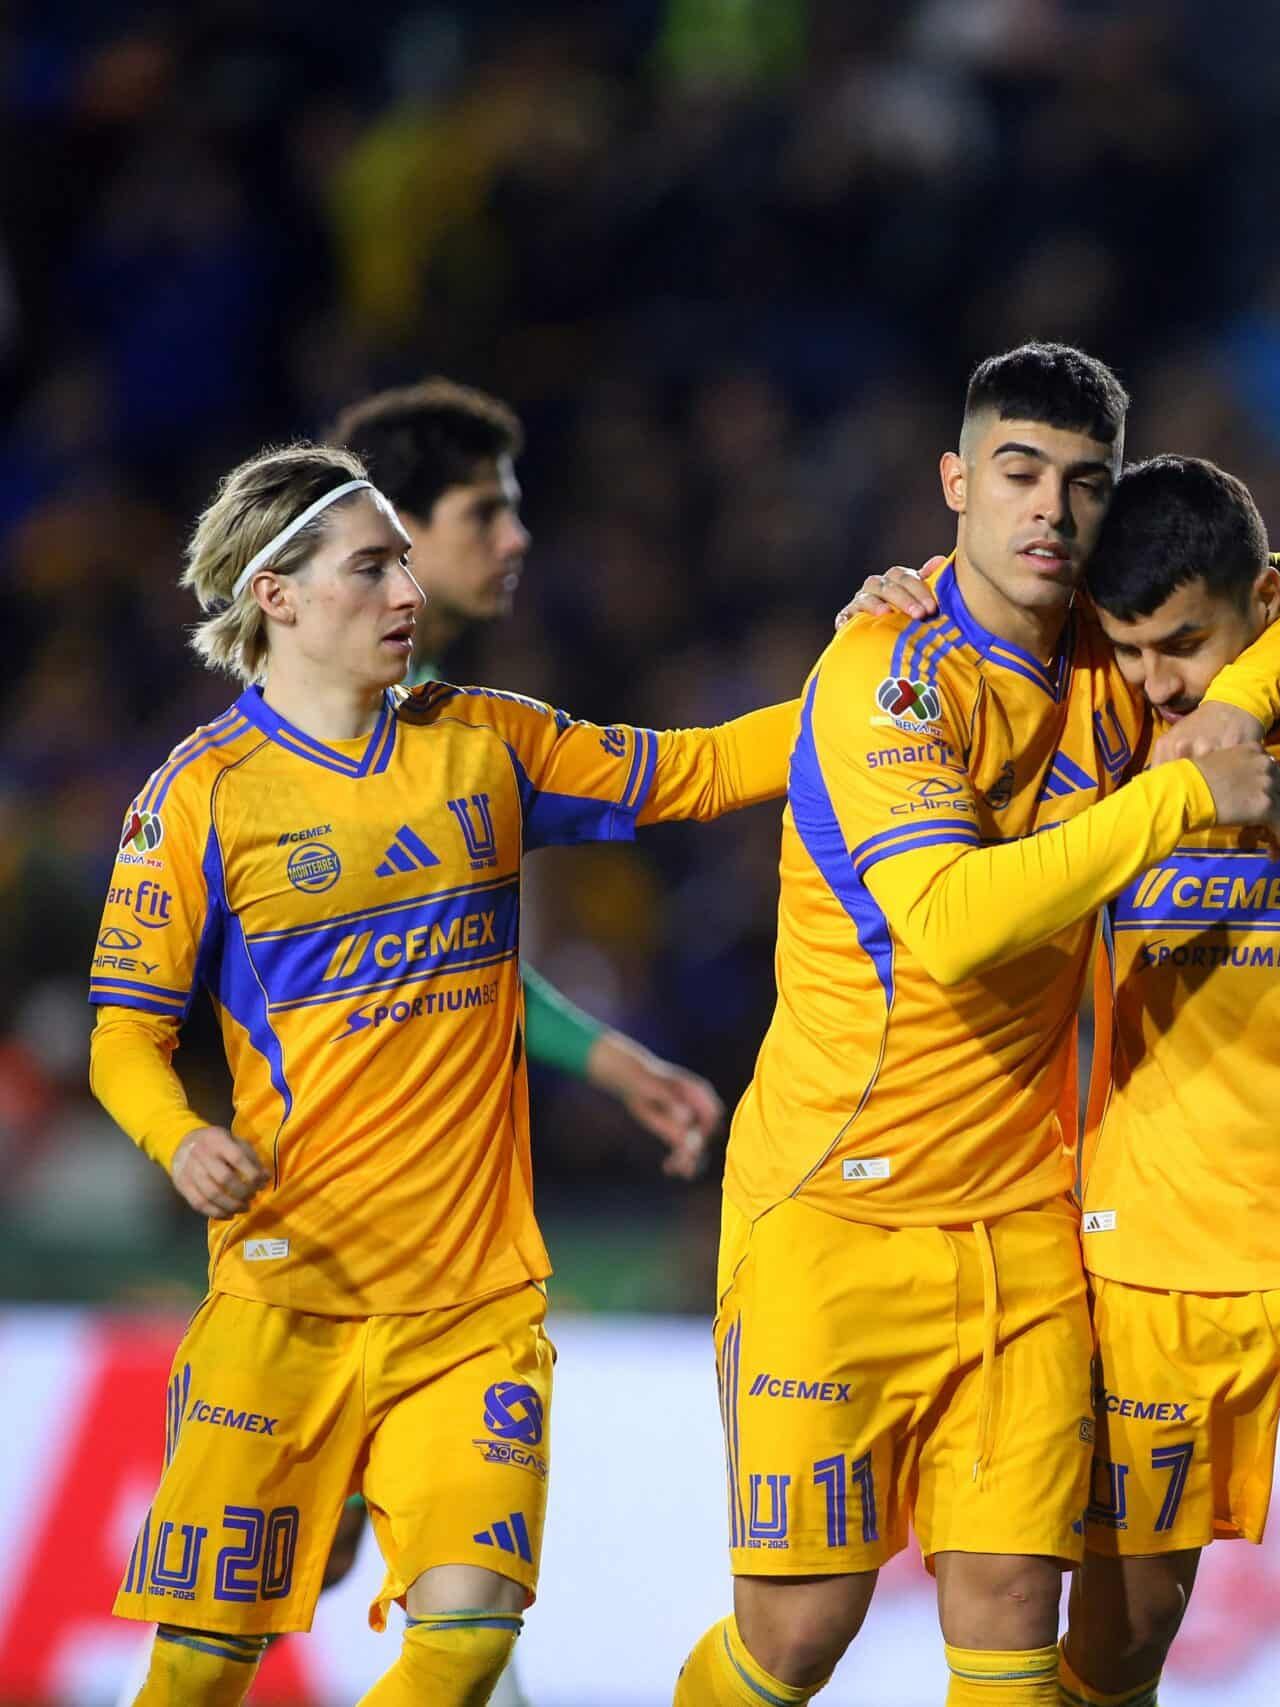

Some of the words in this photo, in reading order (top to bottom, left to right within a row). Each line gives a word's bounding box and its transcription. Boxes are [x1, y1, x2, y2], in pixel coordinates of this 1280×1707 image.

[290, 824, 332, 842] CEMEX
[447, 793, 496, 860] U
[287, 855, 338, 881] MONTERREY
[374, 911, 496, 968] CEMEX
[93, 955, 160, 975] HIREY
[330, 981, 499, 1044] SPORTIUMBET
[768, 1379, 851, 1402] CEMEX
[1106, 1395, 1189, 1421] CEMEX
[198, 1405, 279, 1436] CEMEX
[749, 1474, 791, 1539] U
[813, 1449, 879, 1548] 11
[1152, 1443, 1194, 1532] 7
[151, 1521, 207, 1590] U
[214, 1504, 299, 1603] 20
